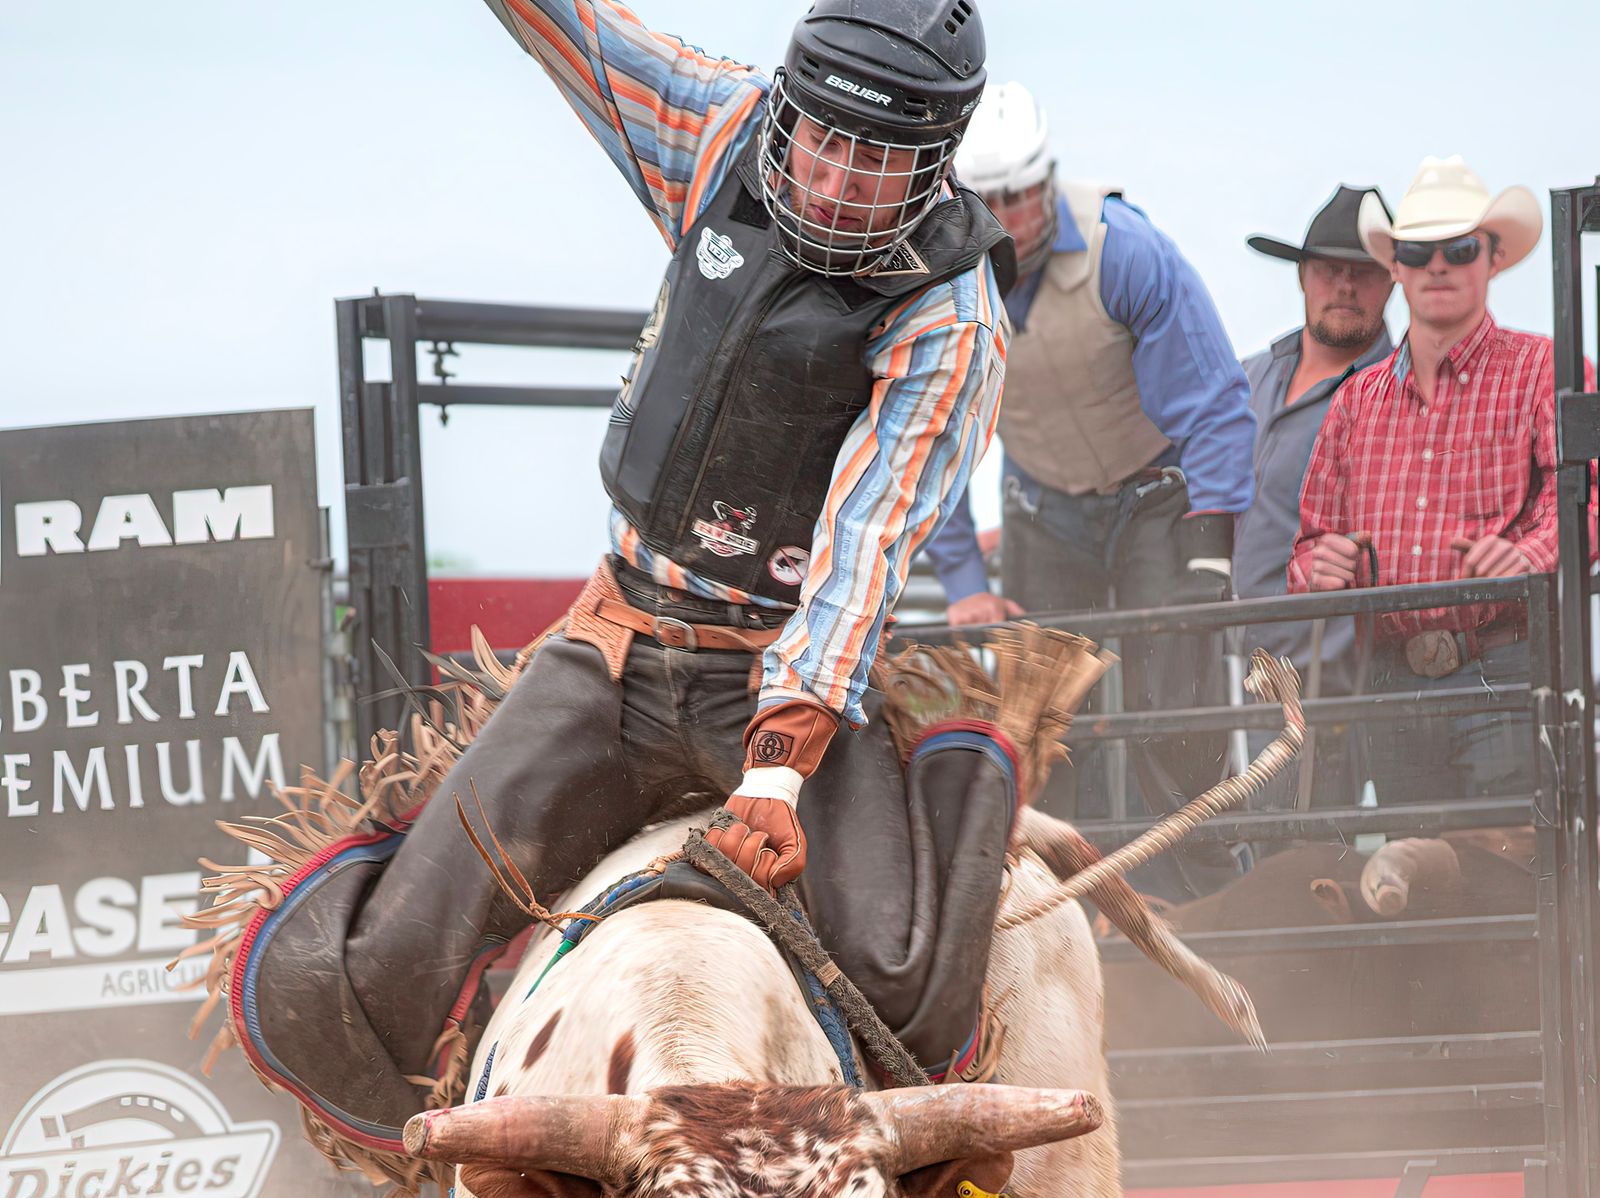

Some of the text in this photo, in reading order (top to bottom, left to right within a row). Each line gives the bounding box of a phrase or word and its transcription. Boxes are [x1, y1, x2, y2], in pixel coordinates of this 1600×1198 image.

[825, 75, 892, 107] BAUER
[15, 485, 274, 557] RAM
[0, 651, 270, 732] BERTA
[0, 733, 287, 817] EMIUM
